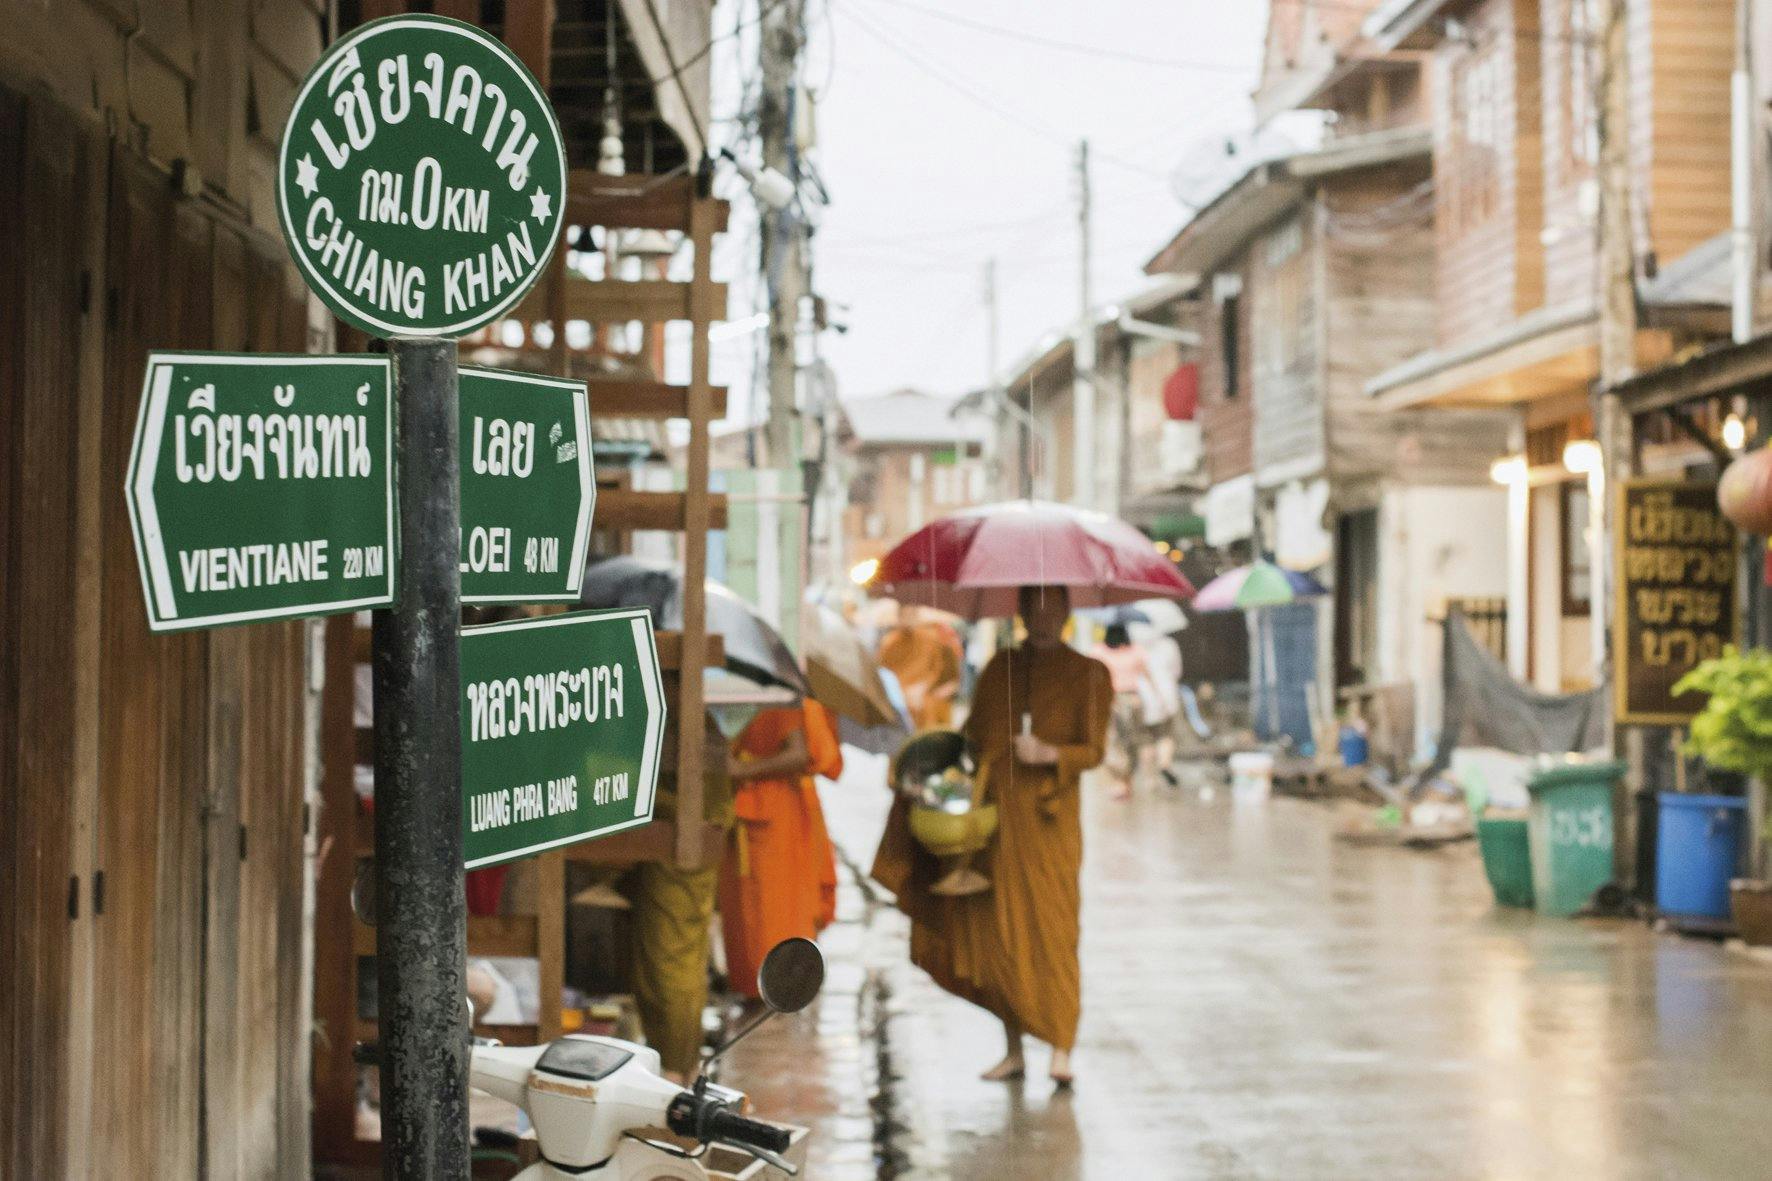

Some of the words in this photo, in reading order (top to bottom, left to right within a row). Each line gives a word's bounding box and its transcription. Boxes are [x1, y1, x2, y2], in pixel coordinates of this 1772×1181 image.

[311, 46, 540, 191] เชียงคาน
[305, 196, 426, 319] CHIANG
[442, 221, 537, 314] KHAN
[175, 382, 371, 483] เวียงจันทน์
[472, 416, 535, 479] เลย
[178, 539, 329, 593] VIENTIANE
[342, 547, 363, 579] 220
[365, 545, 384, 577] KM
[523, 536, 538, 573] 48
[540, 536, 559, 573] KM
[466, 662, 624, 742] หลวงพระบาง
[470, 788, 511, 832] LUANG
[513, 782, 545, 824] PHRA
[547, 774, 578, 816] BANG
[593, 776, 610, 806] 417
[612, 771, 629, 802] KM
